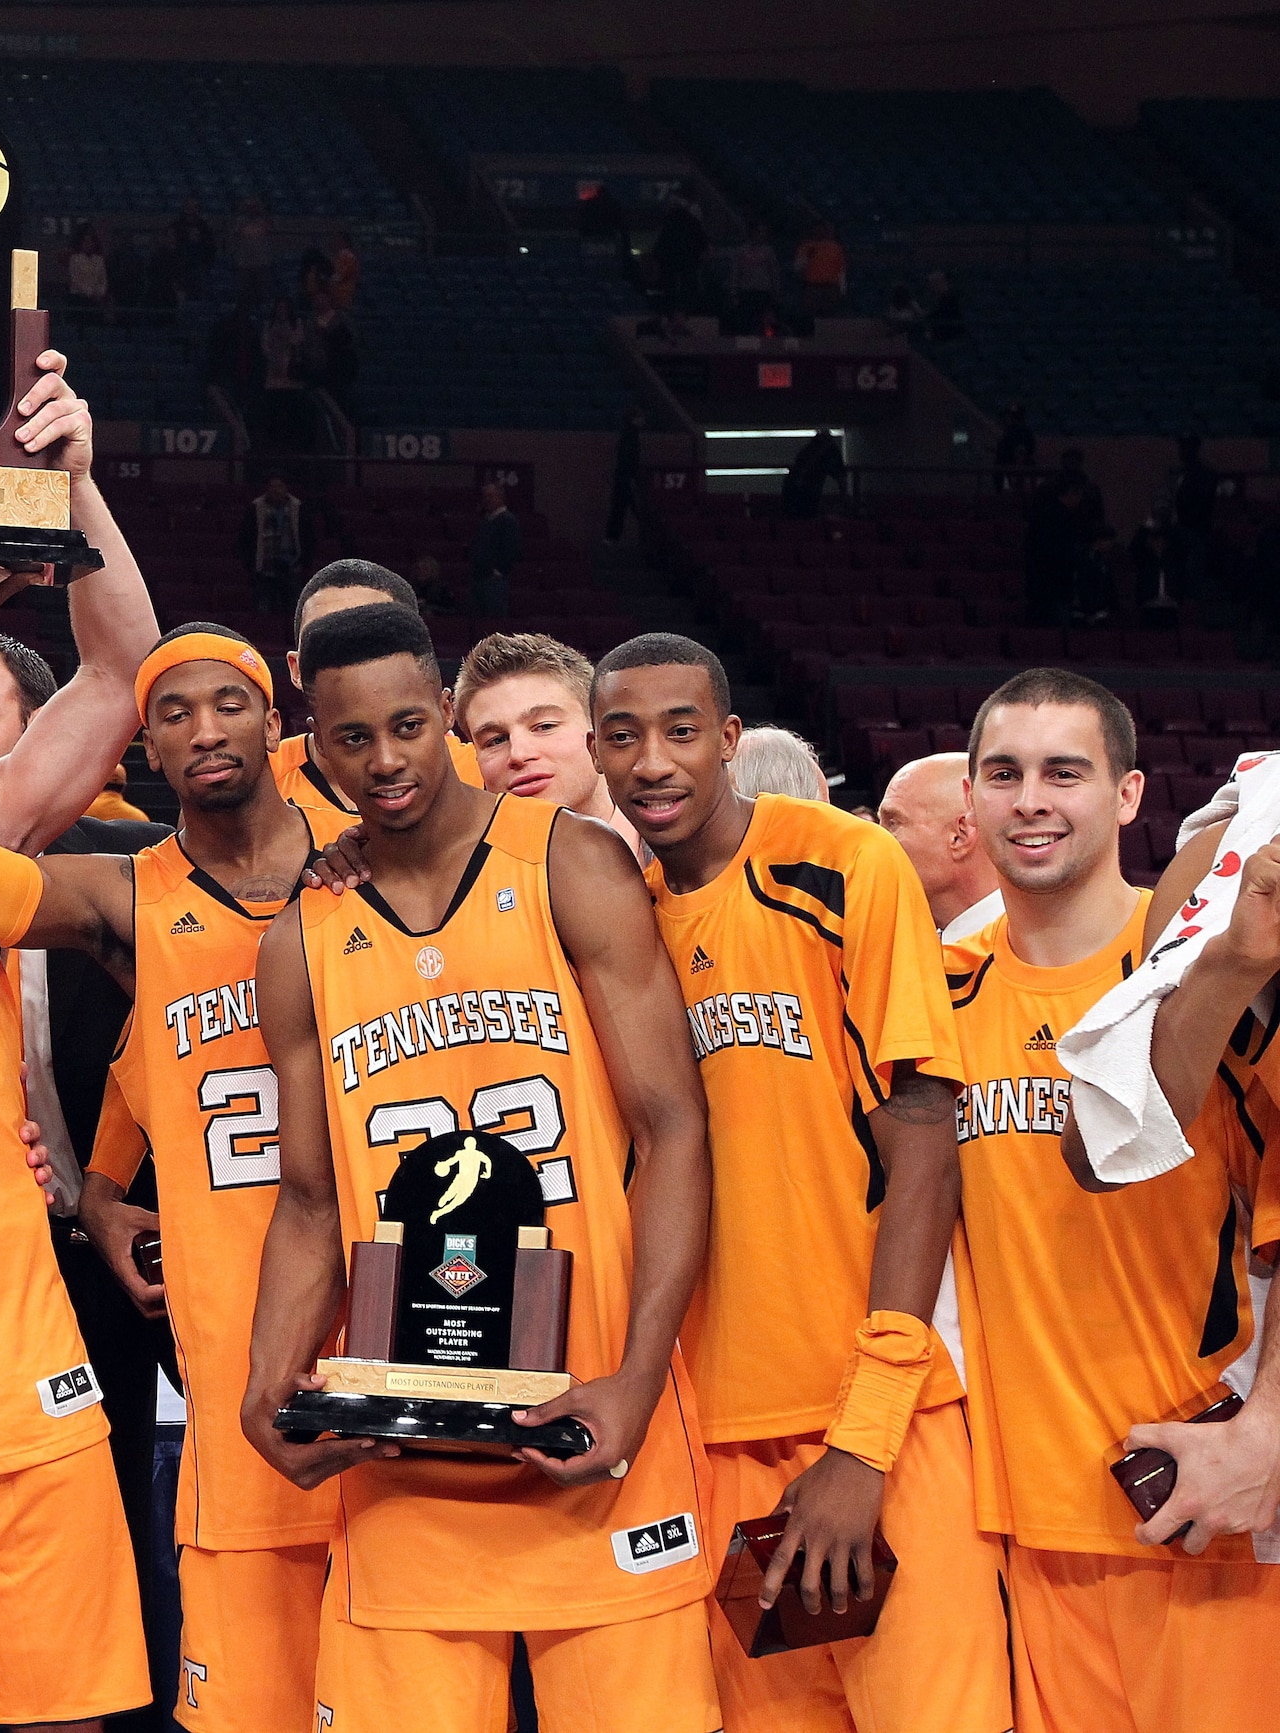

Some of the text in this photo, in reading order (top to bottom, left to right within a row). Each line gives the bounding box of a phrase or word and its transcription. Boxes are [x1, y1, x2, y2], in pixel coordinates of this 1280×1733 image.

[41, 216, 88, 236] 31
[857, 363, 900, 392] 62
[163, 427, 218, 454] 107
[384, 433, 442, 461] 108
[170, 922, 206, 935] adidas
[343, 938, 373, 955] adidas
[418, 948, 443, 977] SEC
[690, 959, 715, 975] adidas
[331, 988, 570, 1094] TENNESSEE
[446, 1237, 474, 1249] DICK'S
[445, 1271, 473, 1281] NIT
[443, 1319, 467, 1328] MOST
[425, 1328, 483, 1338] OUTSTANDING
[438, 1338, 469, 1346] PLAYER
[390, 1377, 494, 1392] MOST OUTSTANDING PLAYER
[56, 1386, 74, 1399] adidas
[666, 1526, 683, 1540] 3XL
[634, 1541, 660, 1554] adidas
